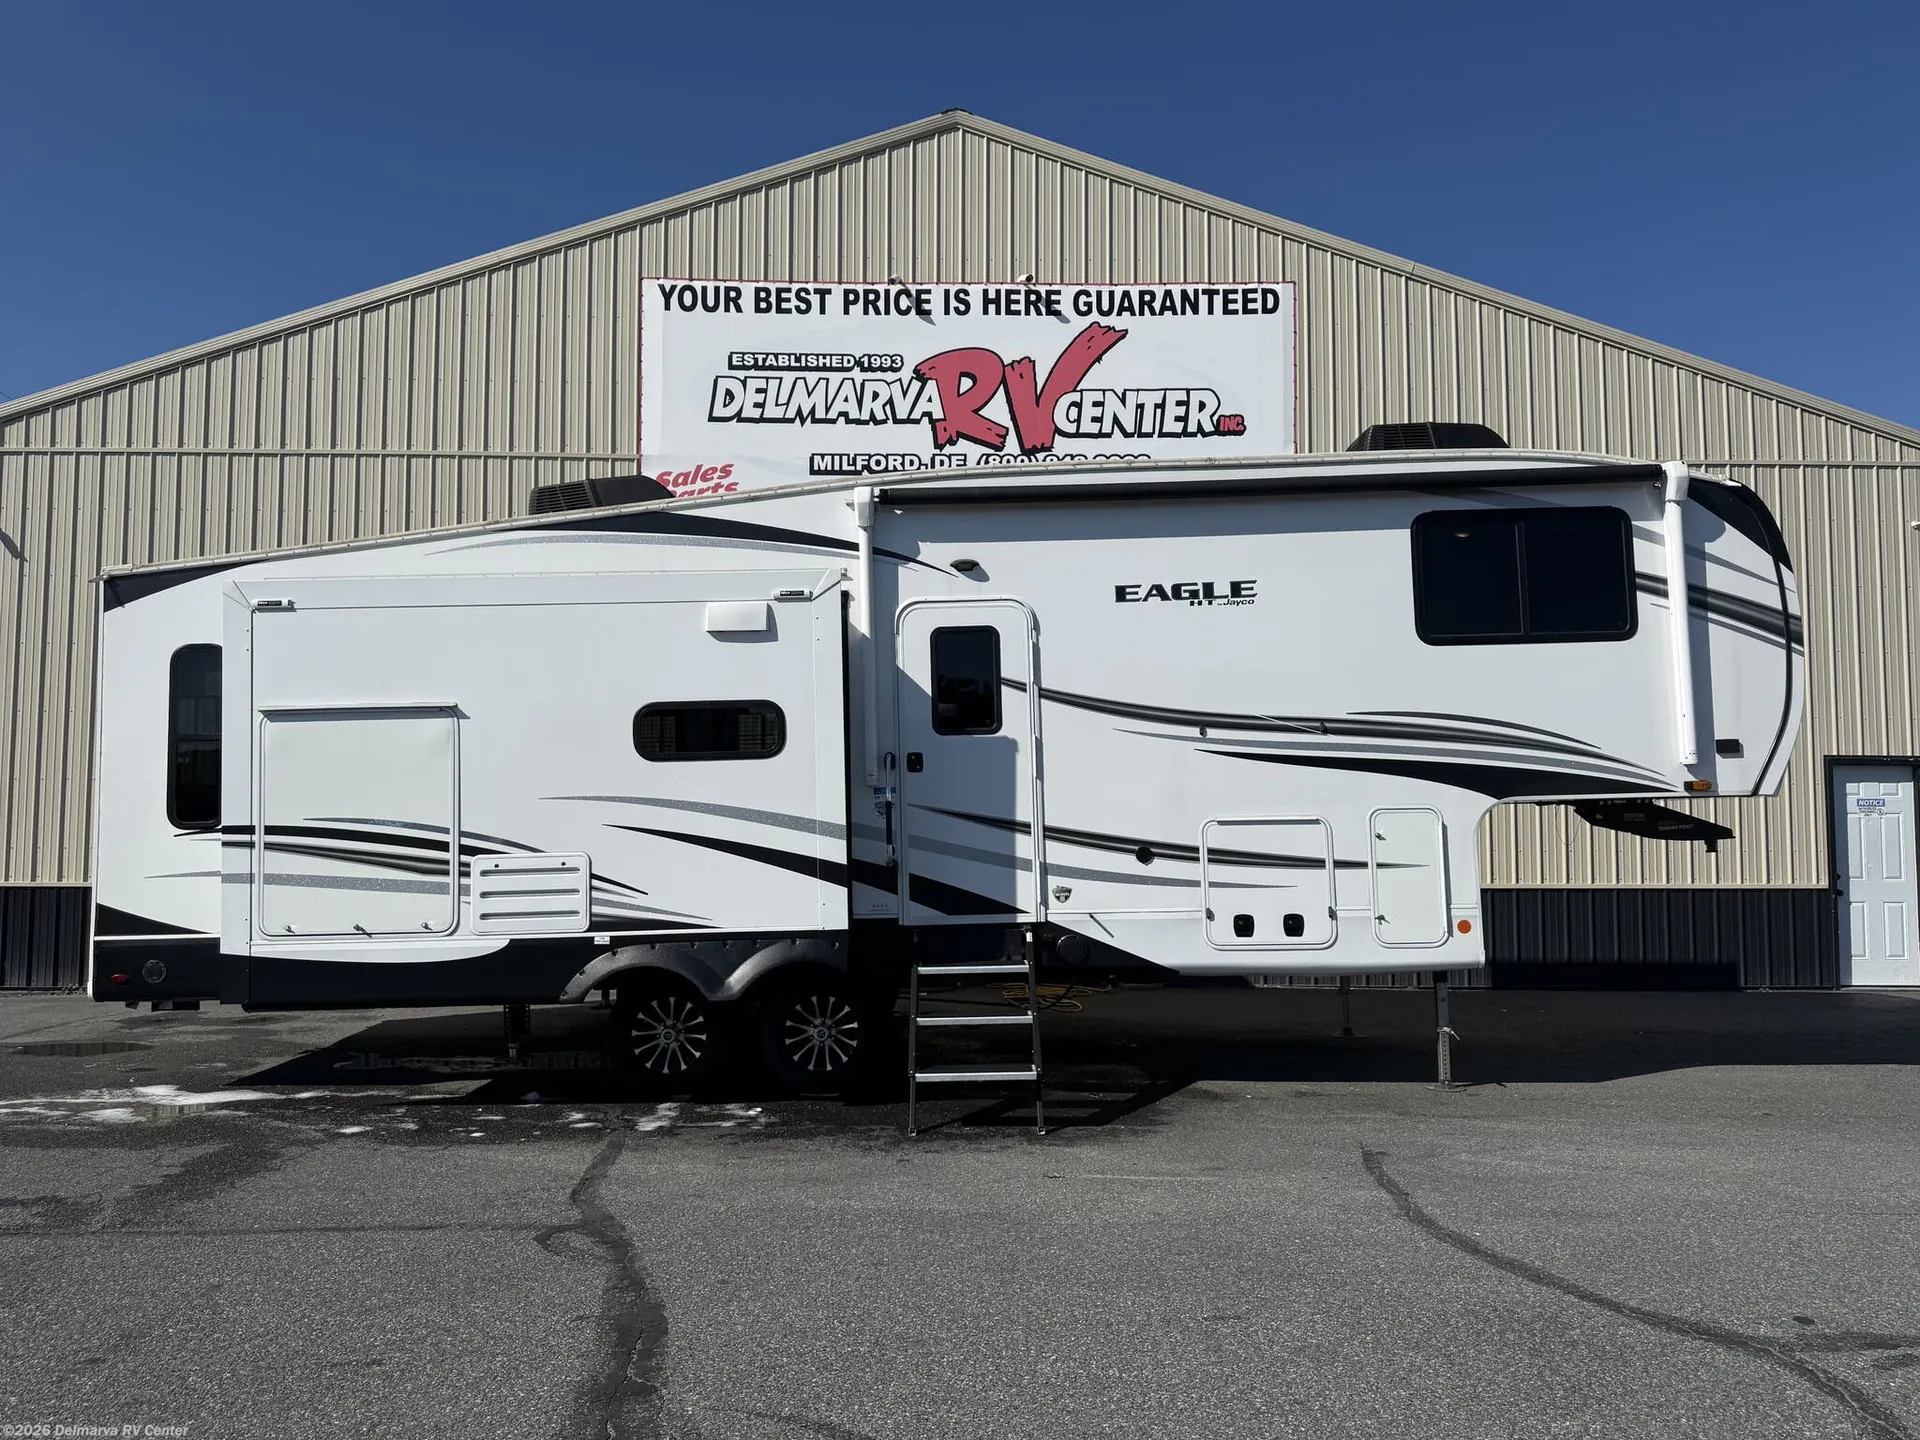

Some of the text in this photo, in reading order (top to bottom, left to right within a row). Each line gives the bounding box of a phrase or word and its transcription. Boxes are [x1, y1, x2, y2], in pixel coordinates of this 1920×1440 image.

[658, 283, 1280, 317] YOUR BEST PRICE IS HERE GUARANTEED
[729, 352, 904, 372] ESTABLISHED 1993
[708, 375, 947, 427] DELMARVA
[912, 321, 1129, 454] RV
[1052, 388, 1221, 439] CENTER
[930, 453, 967, 470] DE
[656, 463, 734, 488] Sales
[671, 481, 739, 498] arts
[1114, 580, 1258, 603] EAGLE
[1189, 599, 1217, 607] HT
[1222, 598, 1255, 607] Jayco
